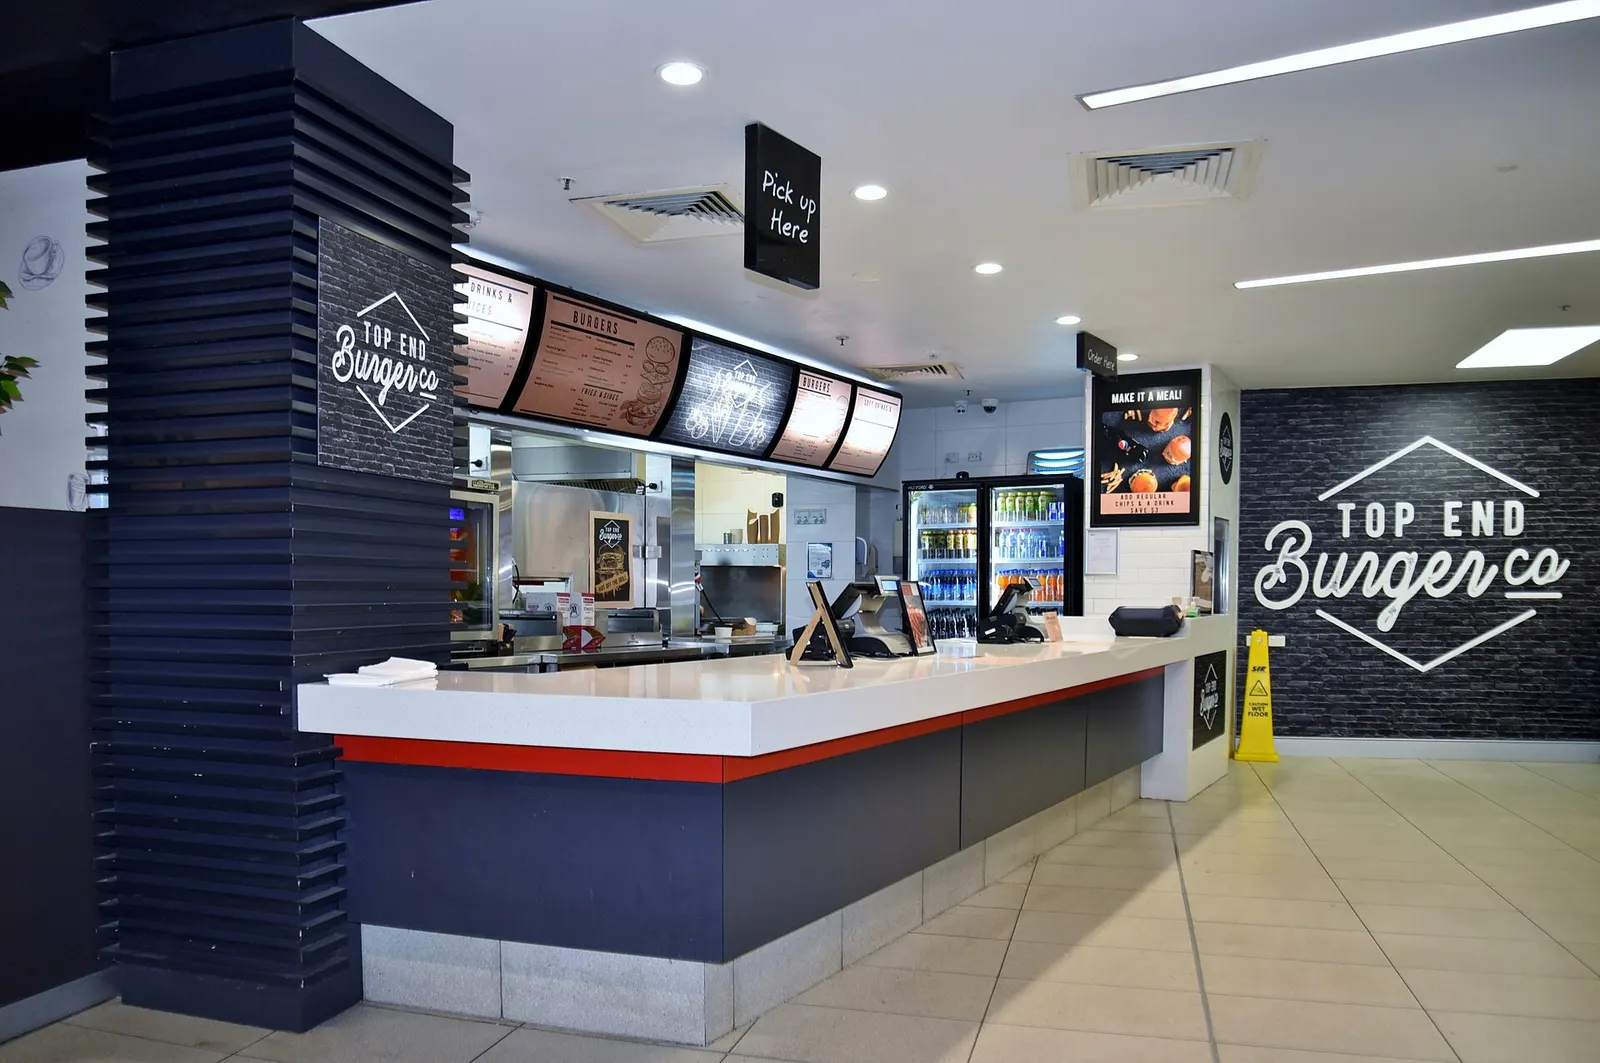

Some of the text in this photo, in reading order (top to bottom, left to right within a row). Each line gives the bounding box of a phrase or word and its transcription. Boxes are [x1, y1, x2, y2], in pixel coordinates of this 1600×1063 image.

[762, 170, 817, 224] Pick up
[770, 208, 809, 244] Here
[470, 282, 503, 301] DRINKS
[508, 292, 513, 304] &
[572, 310, 618, 334] BURGERS
[364, 320, 426, 362] TOP END
[332, 324, 440, 407] Burger co
[1088, 348, 1115, 371] Order Here
[581, 387, 598, 397] FRIES
[603, 392, 620, 401] SIDES
[802, 377, 830, 393] BURGERS
[1112, 389, 1182, 404] MAKE IT A MEAL!
[1337, 501, 1525, 538] TOP END
[1254, 520, 1570, 632] Burger co
